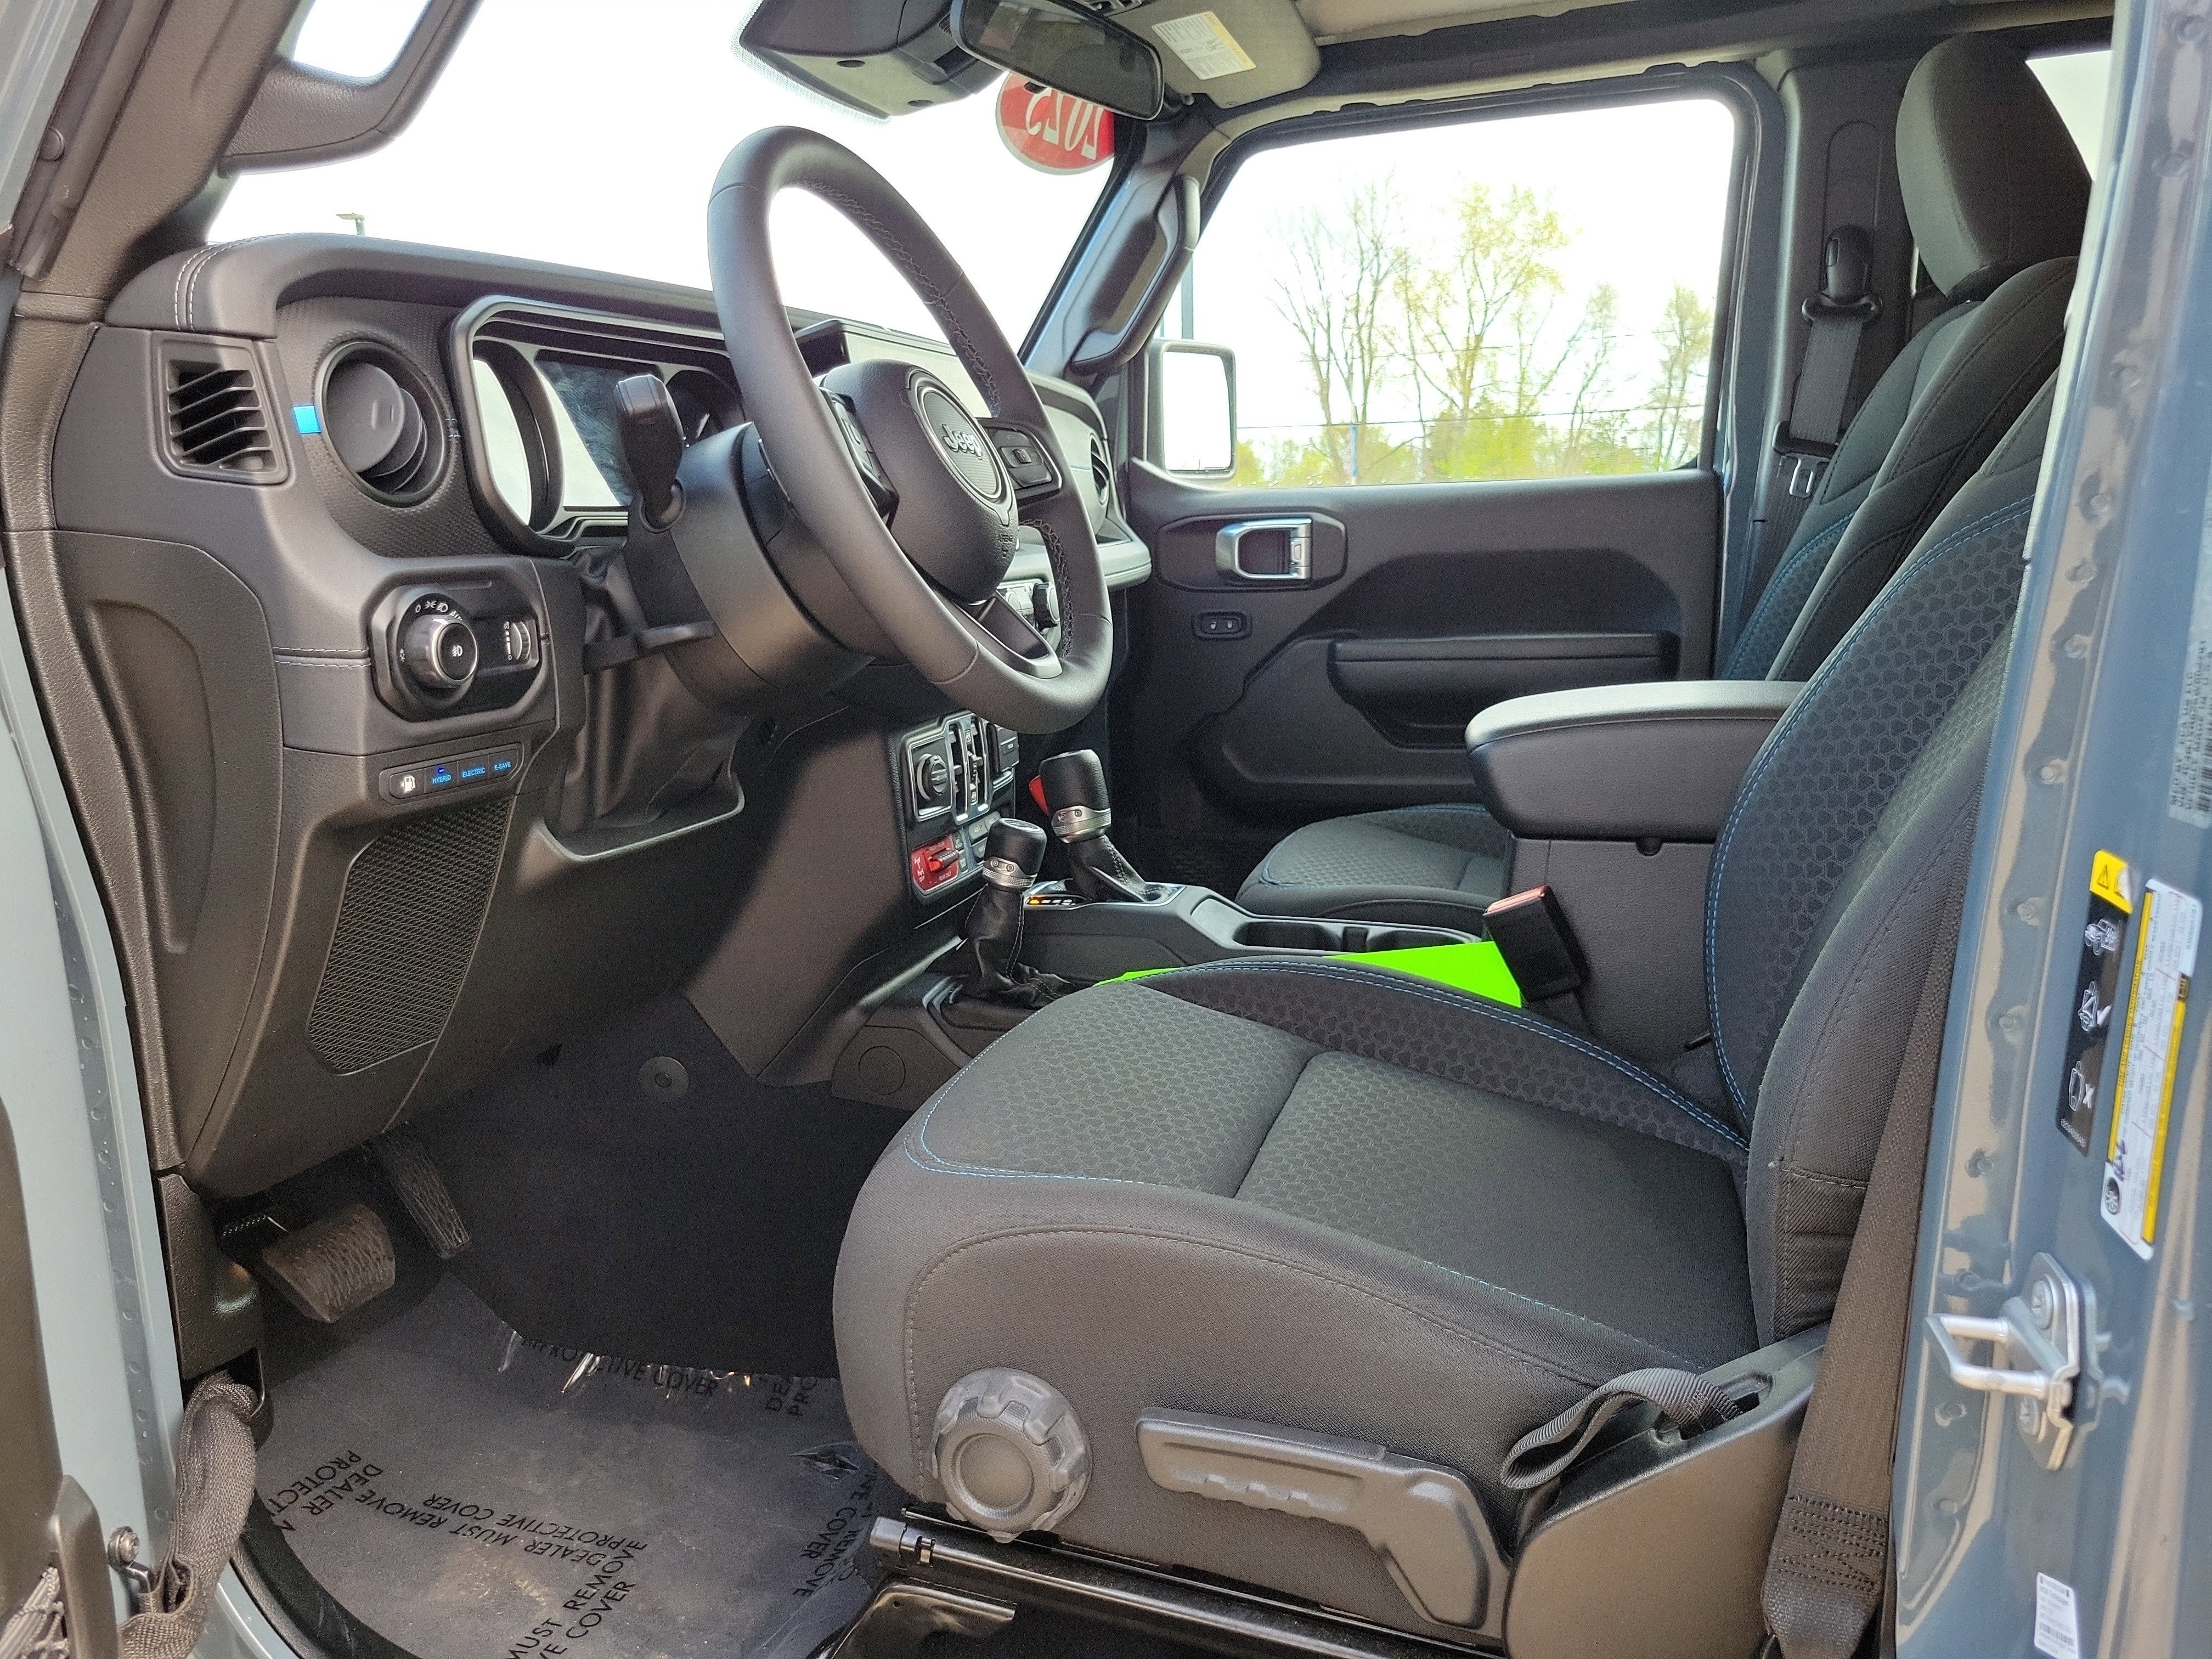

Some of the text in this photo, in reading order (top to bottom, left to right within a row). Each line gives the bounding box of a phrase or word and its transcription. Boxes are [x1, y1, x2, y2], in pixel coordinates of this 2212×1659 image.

[941, 424, 983, 460] Jeep
[432, 775, 452, 784] HYBRID
[462, 767, 486, 778] ELECTRIC
[494, 761, 512, 771] E-SAVE
[653, 1366, 718, 1397] COVER
[301, 1464, 383, 1515] DEALER
[355, 1489, 607, 1566] DEALER MUST REMOVE
[423, 1494, 627, 1549] PROTECTIVE COVER
[799, 1507, 856, 1559] COVER
[563, 1541, 648, 1611] REMOVE
[566, 1581, 636, 1638] COVER
